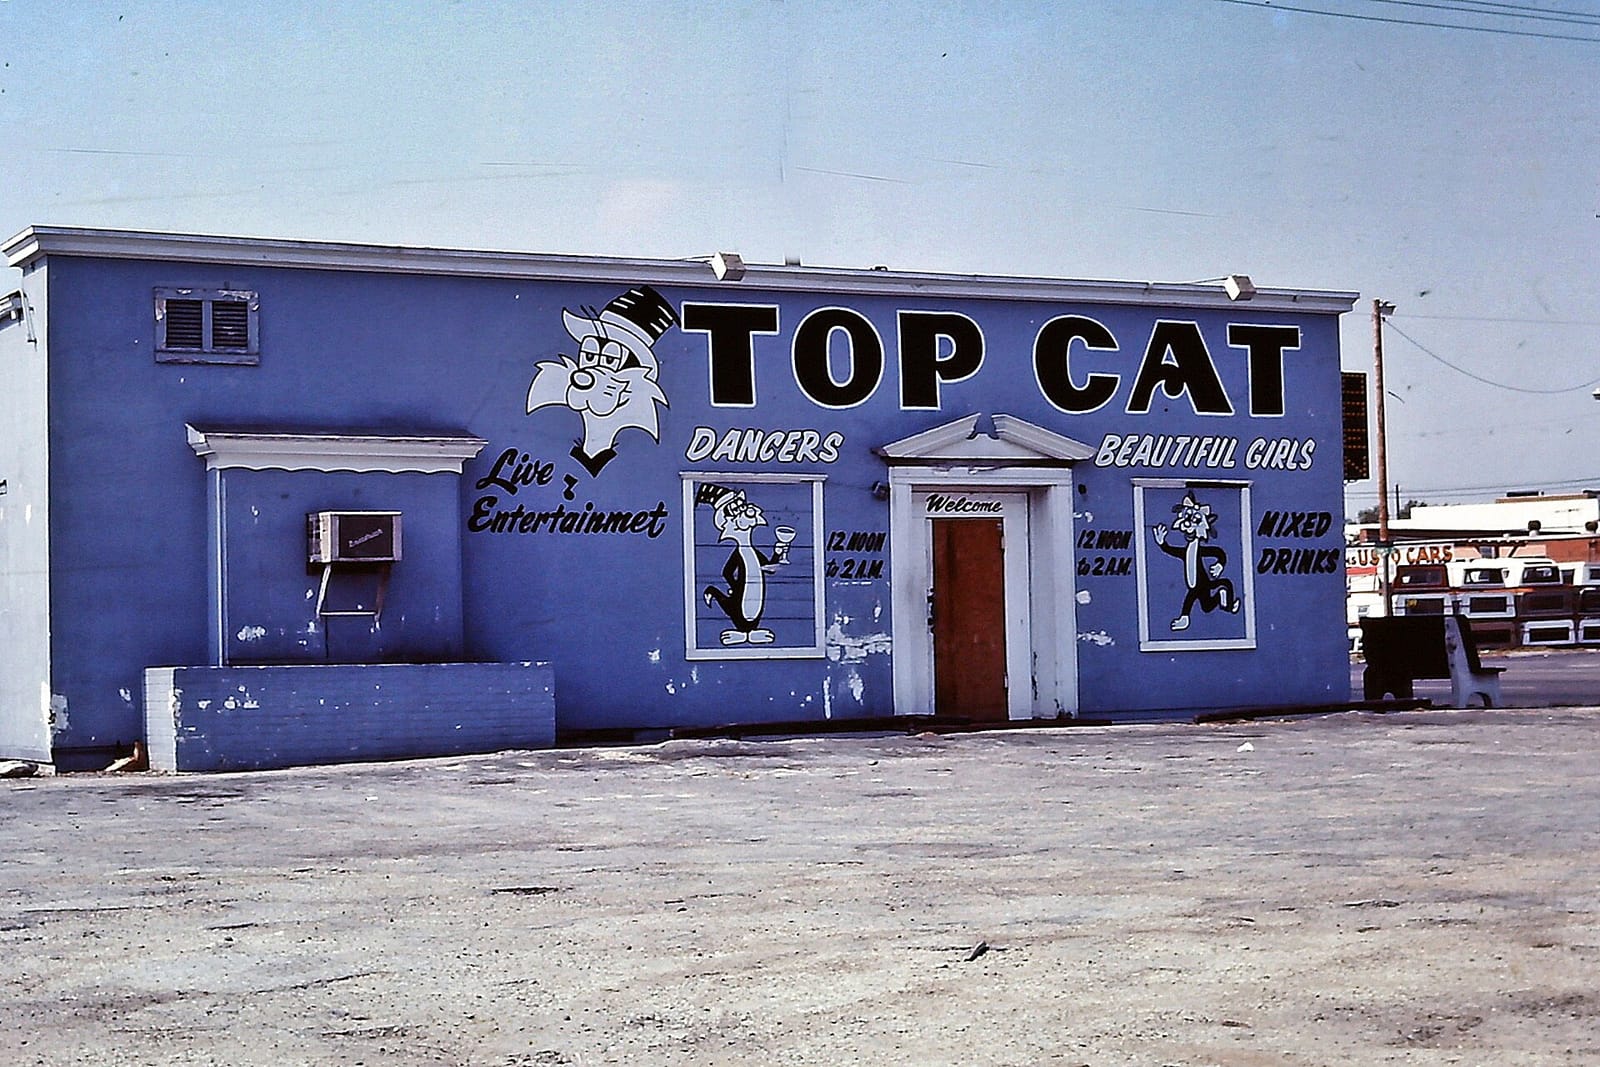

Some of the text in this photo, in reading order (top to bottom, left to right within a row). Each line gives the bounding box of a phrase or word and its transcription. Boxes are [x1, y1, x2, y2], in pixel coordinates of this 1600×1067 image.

[680, 301, 1301, 418] TOP CAT
[685, 426, 844, 463] DANCERS
[1094, 434, 1317, 471] BEAUTIFUL GIRLS
[475, 448, 555, 496] Live
[467, 496, 668, 538] Entertainmet
[926, 493, 1003, 513] Welcome
[1257, 510, 1332, 538] MIXED
[826, 531, 886, 552] 12 NOON
[1077, 529, 1133, 550] 12 NOON
[825, 558, 840, 578] to
[1077, 556, 1091, 576] to
[1256, 547, 1341, 575] DRINKS
[1358, 548, 1401, 565] USD
[1406, 545, 1453, 564] CARS
